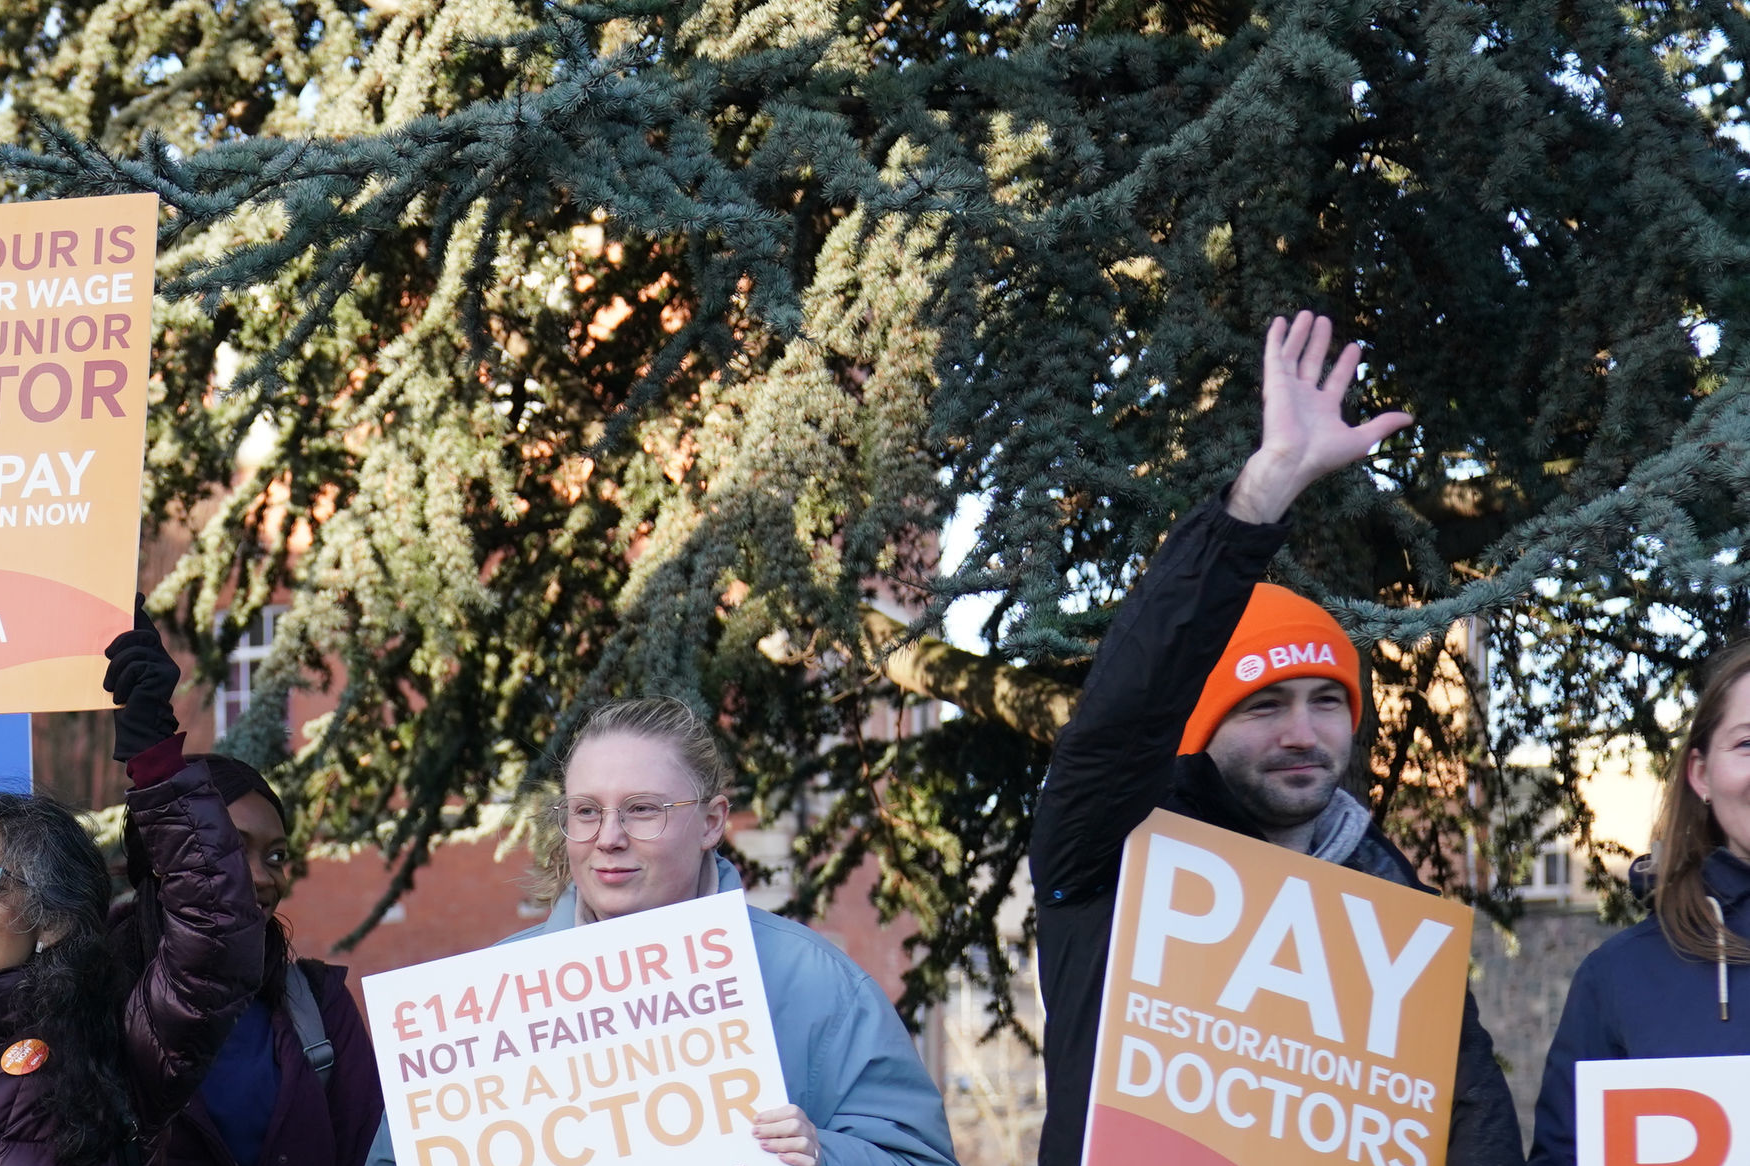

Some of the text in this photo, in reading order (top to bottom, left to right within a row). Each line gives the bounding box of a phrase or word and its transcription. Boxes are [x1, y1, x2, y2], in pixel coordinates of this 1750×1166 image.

[26, 272, 134, 308] WAGE
[93, 225, 137, 265] IS
[25, 502, 91, 527] NOW
[1268, 642, 1336, 669] BMA
[392, 927, 734, 1042] £14/HOUR IS
[1130, 832, 1455, 1059] PAY
[398, 976, 744, 1083] NOT A FAIR WAGE
[405, 1018, 755, 1130] FOR A JUNIOR
[1125, 991, 1436, 1114] RESTORATION FOR
